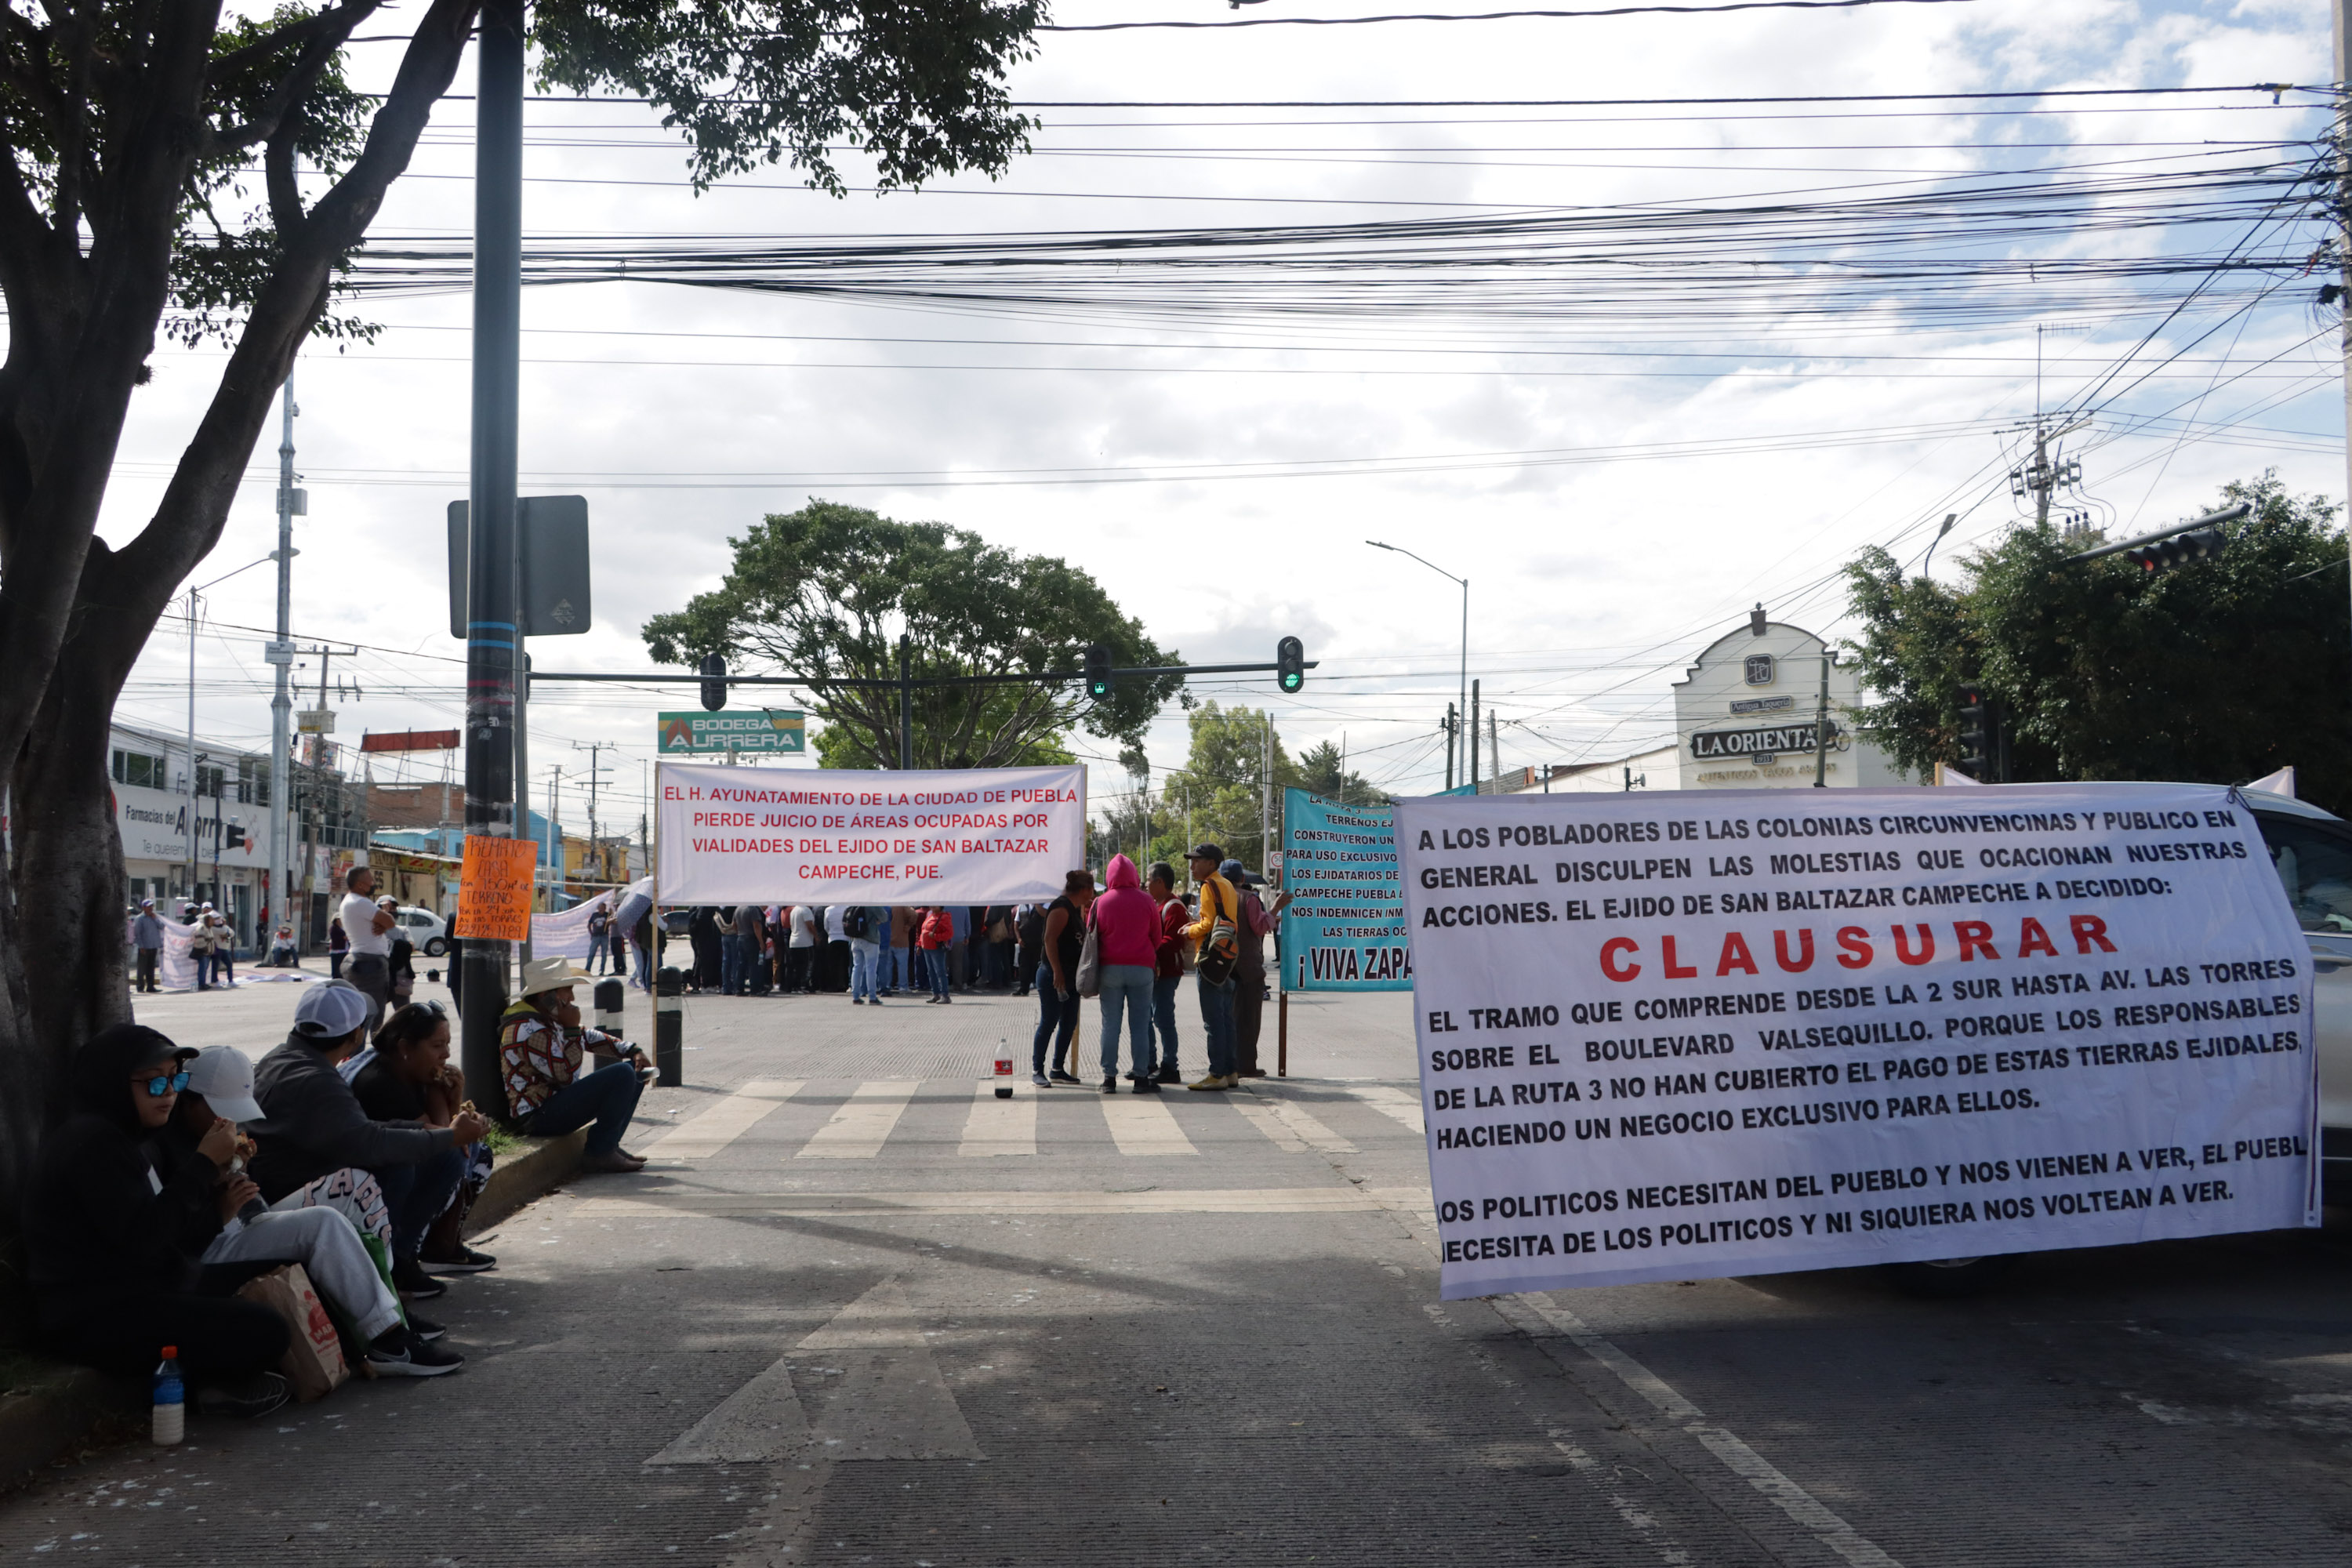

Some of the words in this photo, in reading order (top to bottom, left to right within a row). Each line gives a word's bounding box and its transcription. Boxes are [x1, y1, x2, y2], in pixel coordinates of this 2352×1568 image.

[1733, 701, 1759, 712] Antigua
[692, 719, 774, 730] BODEGA
[668, 733, 796, 747] AURRERA
[1697, 735, 1726, 755] LA
[665, 786, 684, 800] EL
[690, 787, 705, 800] H.
[710, 789, 855, 805] AYUNATAMIENTO
[861, 793, 882, 805] DE
[888, 793, 909, 805] LA
[915, 793, 978, 805] CIUDAD
[984, 790, 1006, 802] DE
[1011, 789, 1077, 803] PUEBLA
[1310, 795, 1322, 804] LA
[126, 804, 163, 824] Farmacias
[165, 811, 176, 825] del
[695, 812, 755, 826] PIERDE
[760, 815, 817, 827] JUICIO
[823, 816, 844, 828] DE
[851, 815, 909, 828] ÁREAS
[914, 814, 1007, 828] OCUPADAS
[1014, 814, 1047, 827] POR
[1326, 814, 1378, 827] TERRENOS
[1294, 829, 1376, 845] CONSTRUYERON
[1419, 830, 1435, 850] A
[1443, 828, 1490, 849] LOS
[1498, 822, 1660, 847] POBLADORES
[1668, 821, 1698, 840] DE
[1705, 819, 1749, 839] LAS
[1757, 817, 1873, 837] COLONIAS
[1880, 813, 2076, 834] CIRCUNVENCINAS
[2081, 812, 2095, 829] Y
[2103, 811, 2198, 829] PUBLICO
[2204, 809, 2236, 827] EN
[143, 840, 152, 853] Te
[471, 836, 526, 858] REMATO
[692, 839, 793, 853] VIALIDADES
[800, 839, 833, 853] DEL
[838, 840, 888, 853] EJIDO
[894, 840, 916, 853] DE
[922, 840, 956, 853] SAN
[962, 839, 1047, 853] BALTAZAR
[1286, 849, 1312, 859] PARA
[1316, 851, 1337, 861] USO
[1340, 851, 1397, 862] EXCLUSIVO
[478, 859, 508, 878] CASA
[799, 866, 899, 880] CAMPECHE,
[906, 866, 942, 879] PUE.
[1421, 865, 1537, 889] GENERAL
[1556, 858, 1691, 882] DISCULPEN
[1709, 856, 1753, 877] LAS
[1770, 851, 1900, 874] MOLESTIAS
[1918, 850, 1964, 870] QUE
[1980, 845, 2112, 867] OCACIONAN
[2129, 841, 2248, 863] NUESTRAS
[1292, 869, 1311, 879] LOS
[1315, 869, 1382, 880] EJIDATARIOS
[1385, 871, 1399, 880] DE
[466, 891, 513, 905] TERRENO
[1294, 888, 1352, 898] CAMPECHE
[1356, 889, 1396, 899] PUEBLA
[1423, 902, 1557, 927] ACCIONES.
[1567, 901, 1595, 920] EL
[1603, 896, 1674, 918] EJIDO
[1683, 895, 1713, 915] DE
[1722, 893, 1767, 913] SAN
[1776, 888, 1896, 911] BALTAZAR
[1903, 884, 2029, 906] CAMPECHE
[2037, 882, 2052, 899] A
[2056, 877, 2172, 898] DECIDIDO:
[1292, 907, 1313, 917] NOS
[1317, 908, 1382, 918] INDEMNICEN
[1323, 927, 1343, 937] LAS
[1346, 927, 1389, 937] TIERRAS
[1601, 916, 2116, 982] CLAUSURAR
[1311, 947, 1359, 980] VIVA
[1429, 1011, 1458, 1033] EL
[1468, 1005, 1559, 1029] TRAMO
[1572, 1002, 1622, 1025] QUE
[1635, 993, 1786, 1020] COMPRENDE
[1797, 987, 1875, 1011] DESDE
[1886, 985, 1918, 1004] LA
[1927, 983, 1942, 1002] 2
[1953, 978, 2002, 1000] SUR
[2012, 974, 2090, 996] HASTA
[2101, 970, 2135, 990] AV.
[2145, 966, 2190, 987] LAS
[2200, 959, 2295, 983] TORRES
[1432, 1047, 1513, 1071] SOBRE
[1530, 1044, 1559, 1065] EL
[1585, 1033, 1733, 1062] BOULEVARD
[1759, 1021, 1933, 1050] VALSEQUILLO.
[1945, 1013, 2045, 1038] PORQUE
[2056, 1009, 2101, 1030] LOS
[2114, 994, 2299, 1026] RESPONSABLES
[1435, 1088, 1465, 1110] DE
[1475, 1086, 1505, 1108] LA
[1512, 1082, 1581, 1105] RUTA
[1589, 1080, 1602, 1100] 3
[1610, 1077, 1645, 1098] NO
[1655, 1073, 1706, 1095] HAN
[1715, 1065, 1838, 1091] CUBIERTO
[1847, 1062, 1876, 1083] EL
[1884, 1057, 1947, 1080] PAGO
[1957, 1054, 1987, 1075] DE
[1996, 1048, 2069, 1072] ESTAS
[2076, 1040, 2179, 1065] TIERRAS
[2187, 1031, 2302, 1060] EJIDALES,
[1438, 1120, 1565, 1149] HACIENDO
[1575, 1118, 1610, 1140] UN
[1621, 1110, 1733, 1137] NEGOCIO
[1742, 1099, 1878, 1128] EXCLUSIVO
[1886, 1094, 1951, 1118] PARA
[1958, 1088, 2039, 1112] ELLOS.
[1437, 1200, 1474, 1224] OS
[1483, 1190, 1618, 1219] POLITICOS
[1627, 1179, 1767, 1209] NECESITAN
[1777, 1176, 1824, 1198] DEL
[1831, 1167, 1927, 1194] PUEBLO
[1935, 1165, 1951, 1185] Y
[1959, 1161, 2009, 1184] NOS
[2016, 1153, 2107, 1179] VIENEN
[2116, 1152, 2132, 1171] A
[2138, 1147, 2194, 1171] VER,
[2202, 1144, 2227, 1164] EL
[1443, 1235, 1555, 1263] ECESITA
[1563, 1232, 1595, 1254] DE
[1604, 1227, 1652, 1250] LOS
[1661, 1216, 1792, 1246] POLITICOS
[1800, 1214, 1817, 1235] Y
[1826, 1212, 1852, 1233] NI
[1860, 1202, 1976, 1231] SIQUIERA
[1984, 1197, 2034, 1220] NOS
[2042, 1188, 2151, 1215] VOLTEAN
[2159, 1185, 2176, 1205] A
[2183, 1181, 2233, 1203] VER.
